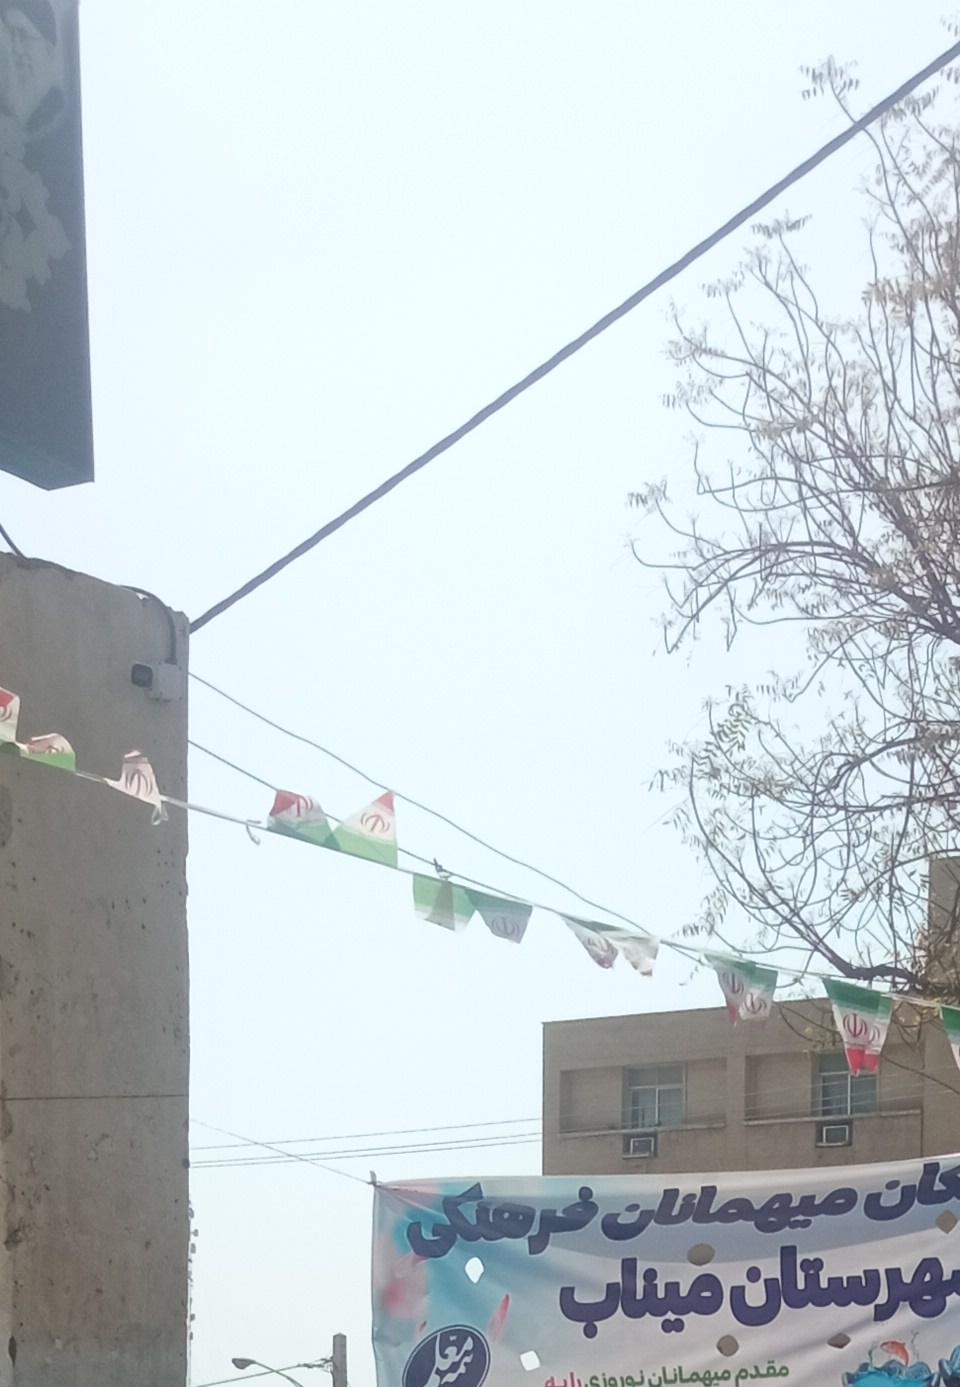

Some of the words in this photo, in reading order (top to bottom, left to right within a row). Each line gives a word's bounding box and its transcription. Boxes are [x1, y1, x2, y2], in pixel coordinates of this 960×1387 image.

[602, 1184, 858, 1241] میهمانان
[559, 1257, 724, 1338] میناب
[735, 1360, 790, 1387] مقدم
